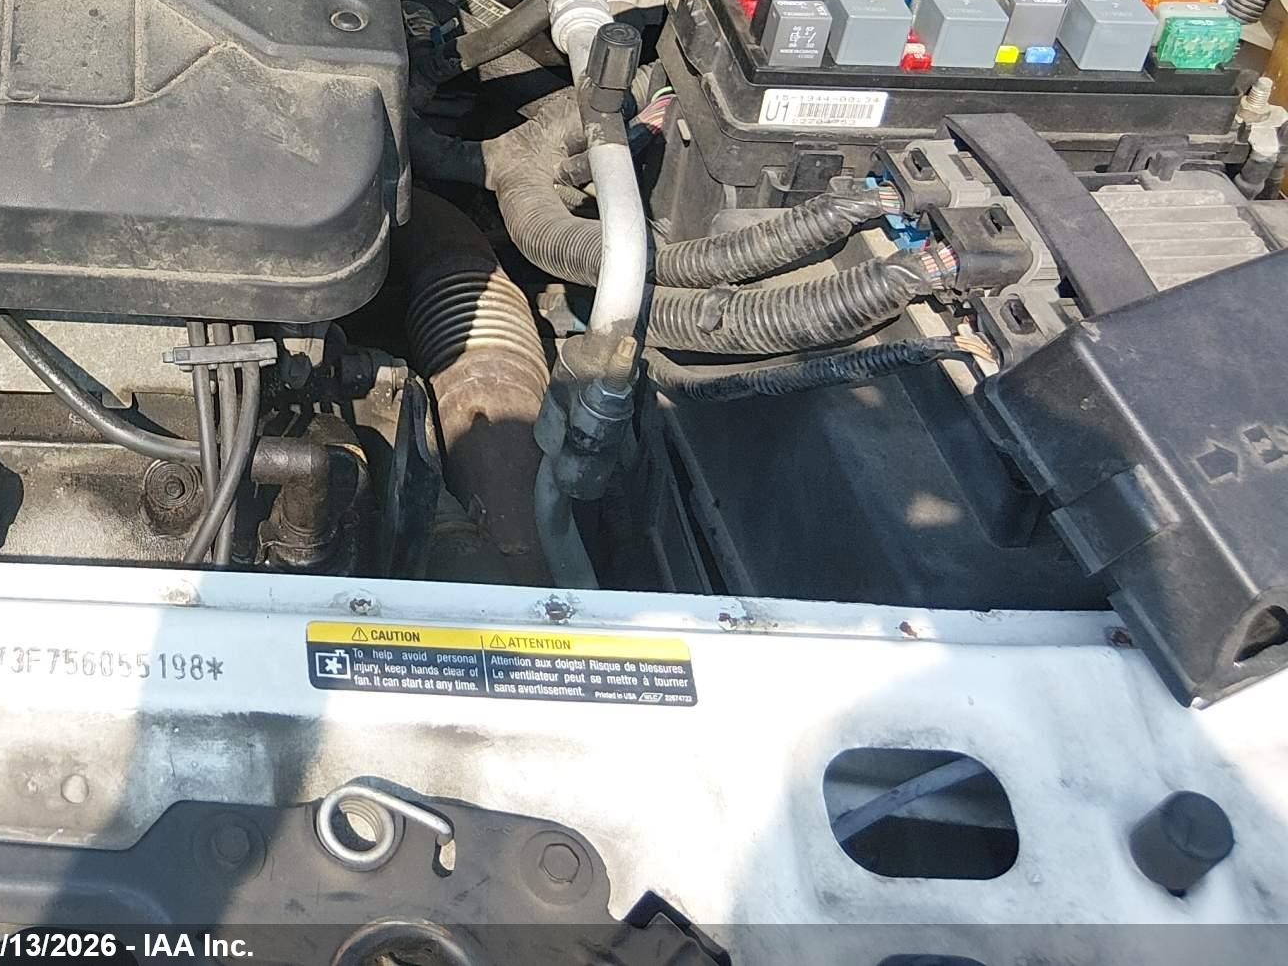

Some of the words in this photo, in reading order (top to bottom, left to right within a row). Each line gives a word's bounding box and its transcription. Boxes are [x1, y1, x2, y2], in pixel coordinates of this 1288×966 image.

[766, 100, 790, 122] U1
[371, 630, 420, 642] CAUTION
[508, 637, 570, 650] ATTENTION
[353, 648, 364, 658] To
[372, 650, 393, 661] help
[402, 651, 428, 662] avoid
[437, 653, 477, 664] personal
[353, 662, 381, 674] injury,
[384, 663, 407, 676] keep
[411, 664, 439, 675] hands
[442, 666, 464, 677] clear
[469, 667, 478, 678] of
[491, 656, 531, 667] Attention
[535, 659, 551, 668] aux
[555, 658, 585, 671] doigts!
[590, 660, 620, 674] Risque
[624, 662, 636, 672] de
[640, 662, 686, 675] blessures.
[354, 676, 372, 686] fan.
[374, 676, 381, 686] It
[382, 678, 400, 687] can
[401, 679, 423, 690] start
[424, 680, 434, 690] at
[436, 682, 453, 692] any
[455, 680, 479, 692] time.
[492, 669, 504, 679] Le
[510, 670, 559, 682] ventilateur
[564, 674, 586, 685] peut
[590, 676, 602, 684] se
[607, 675, 638, 686] mettre
[642, 675, 650, 686] à
[654, 677, 688, 688] tourner
[494, 684, 516, 694] sans
[518, 684, 585, 697] avertissement.
[595, 691, 616, 699] Printed
